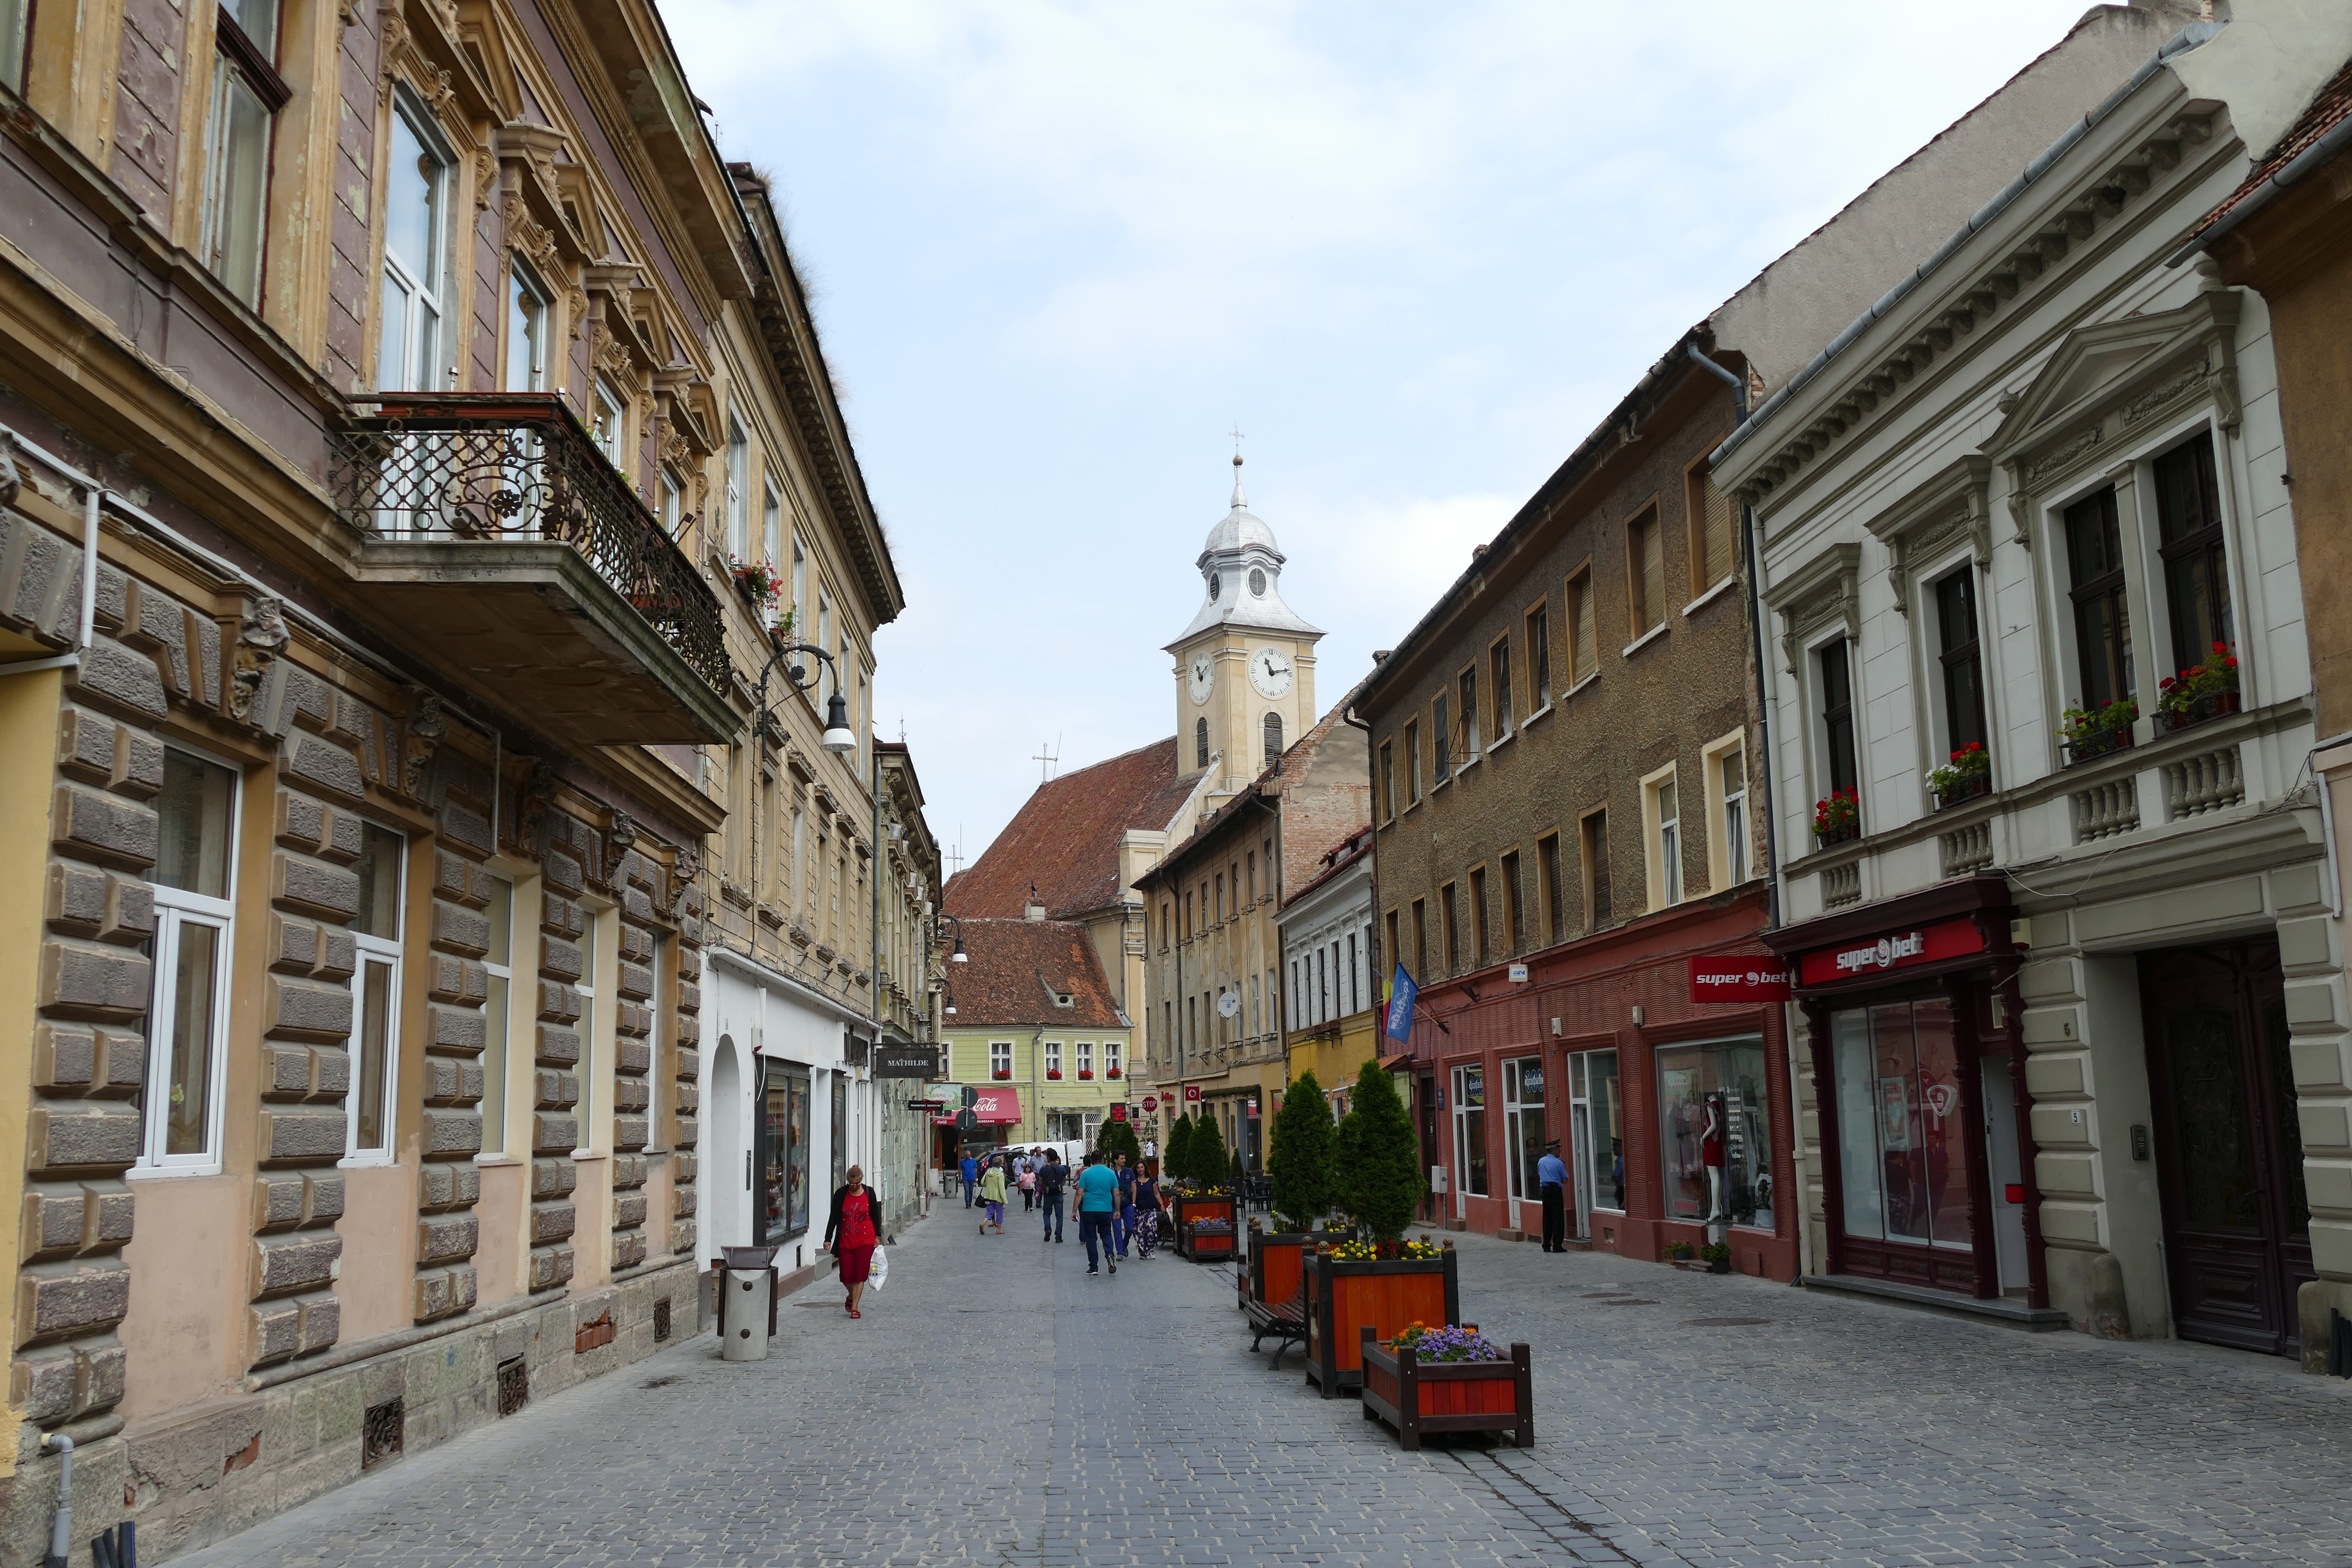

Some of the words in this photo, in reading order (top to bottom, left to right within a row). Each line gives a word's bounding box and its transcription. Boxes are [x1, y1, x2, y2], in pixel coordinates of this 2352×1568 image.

[1837, 946, 1878, 972] super
[1892, 932, 1920, 959] bet
[1696, 974, 1743, 986] super
[1760, 971, 1788, 983] bet
[2063, 1023, 2070, 1036] 5
[2073, 1113, 2077, 1123] 5
